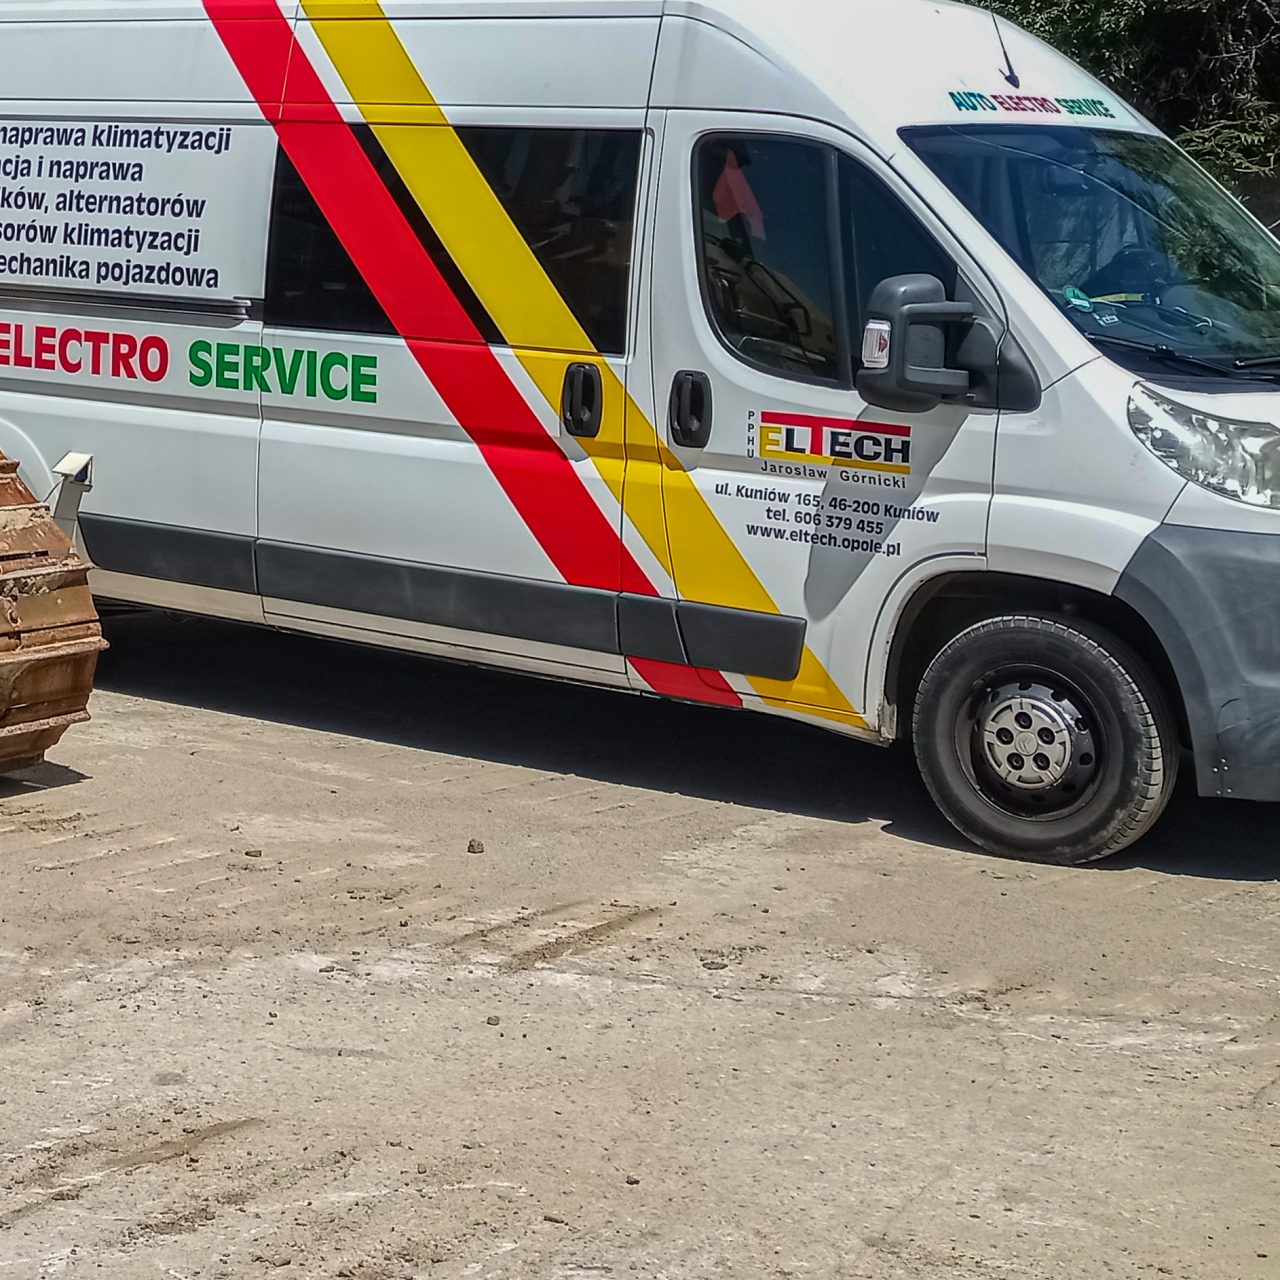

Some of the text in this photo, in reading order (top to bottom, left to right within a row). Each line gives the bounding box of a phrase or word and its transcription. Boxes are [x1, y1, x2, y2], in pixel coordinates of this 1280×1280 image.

[949, 92, 1116, 118] AUTO ELECTRO SERVICE
[91, 124, 232, 152] klimatyzacji
[36, 155, 44, 177] i
[48, 158, 144, 183] naprawa
[55, 189, 206, 219] alternatorów
[62, 222, 200, 255] klimatyzacji
[96, 264, 219, 288] pojazdowa
[188, 339, 378, 403] SERVICE
[759, 411, 911, 475] ELTECH
[760, 460, 906, 489] Jarosław Górnicki
[715, 483, 940, 523] ul. Kuniów 165, 46-200 Kuniów
[766, 507, 883, 535] tel. 606 379 455
[746, 523, 901, 557] www.eltech.opole.pl
